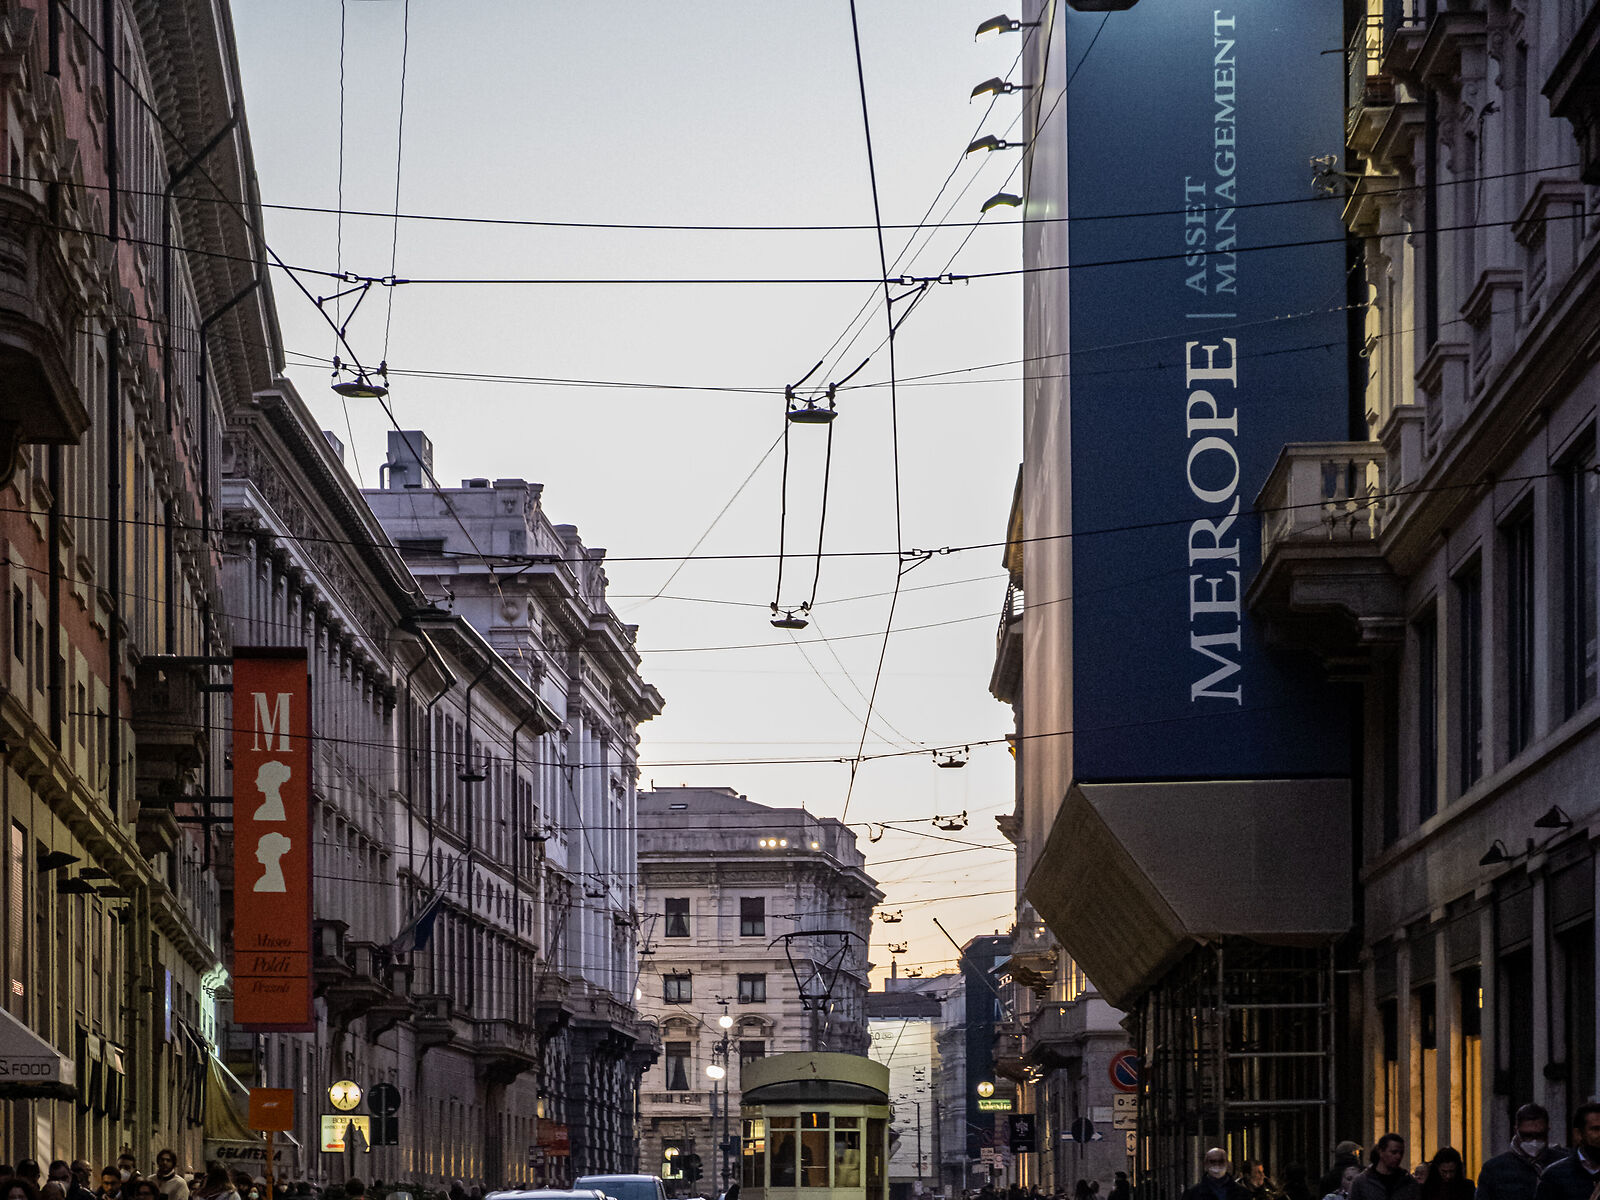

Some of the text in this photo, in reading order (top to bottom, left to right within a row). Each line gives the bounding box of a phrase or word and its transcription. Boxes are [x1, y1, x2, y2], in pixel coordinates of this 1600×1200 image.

[1212, 9, 1239, 297] MANAGEMENT
[1184, 175, 1209, 296] ASSET
[1184, 336, 1243, 707] MEROPE
[250, 692, 294, 753] M
[254, 932, 291, 947] Museo
[252, 955, 291, 972] Poldi
[12, 1063, 51, 1076] FOOD
[217, 1146, 283, 1162] GELATERA
